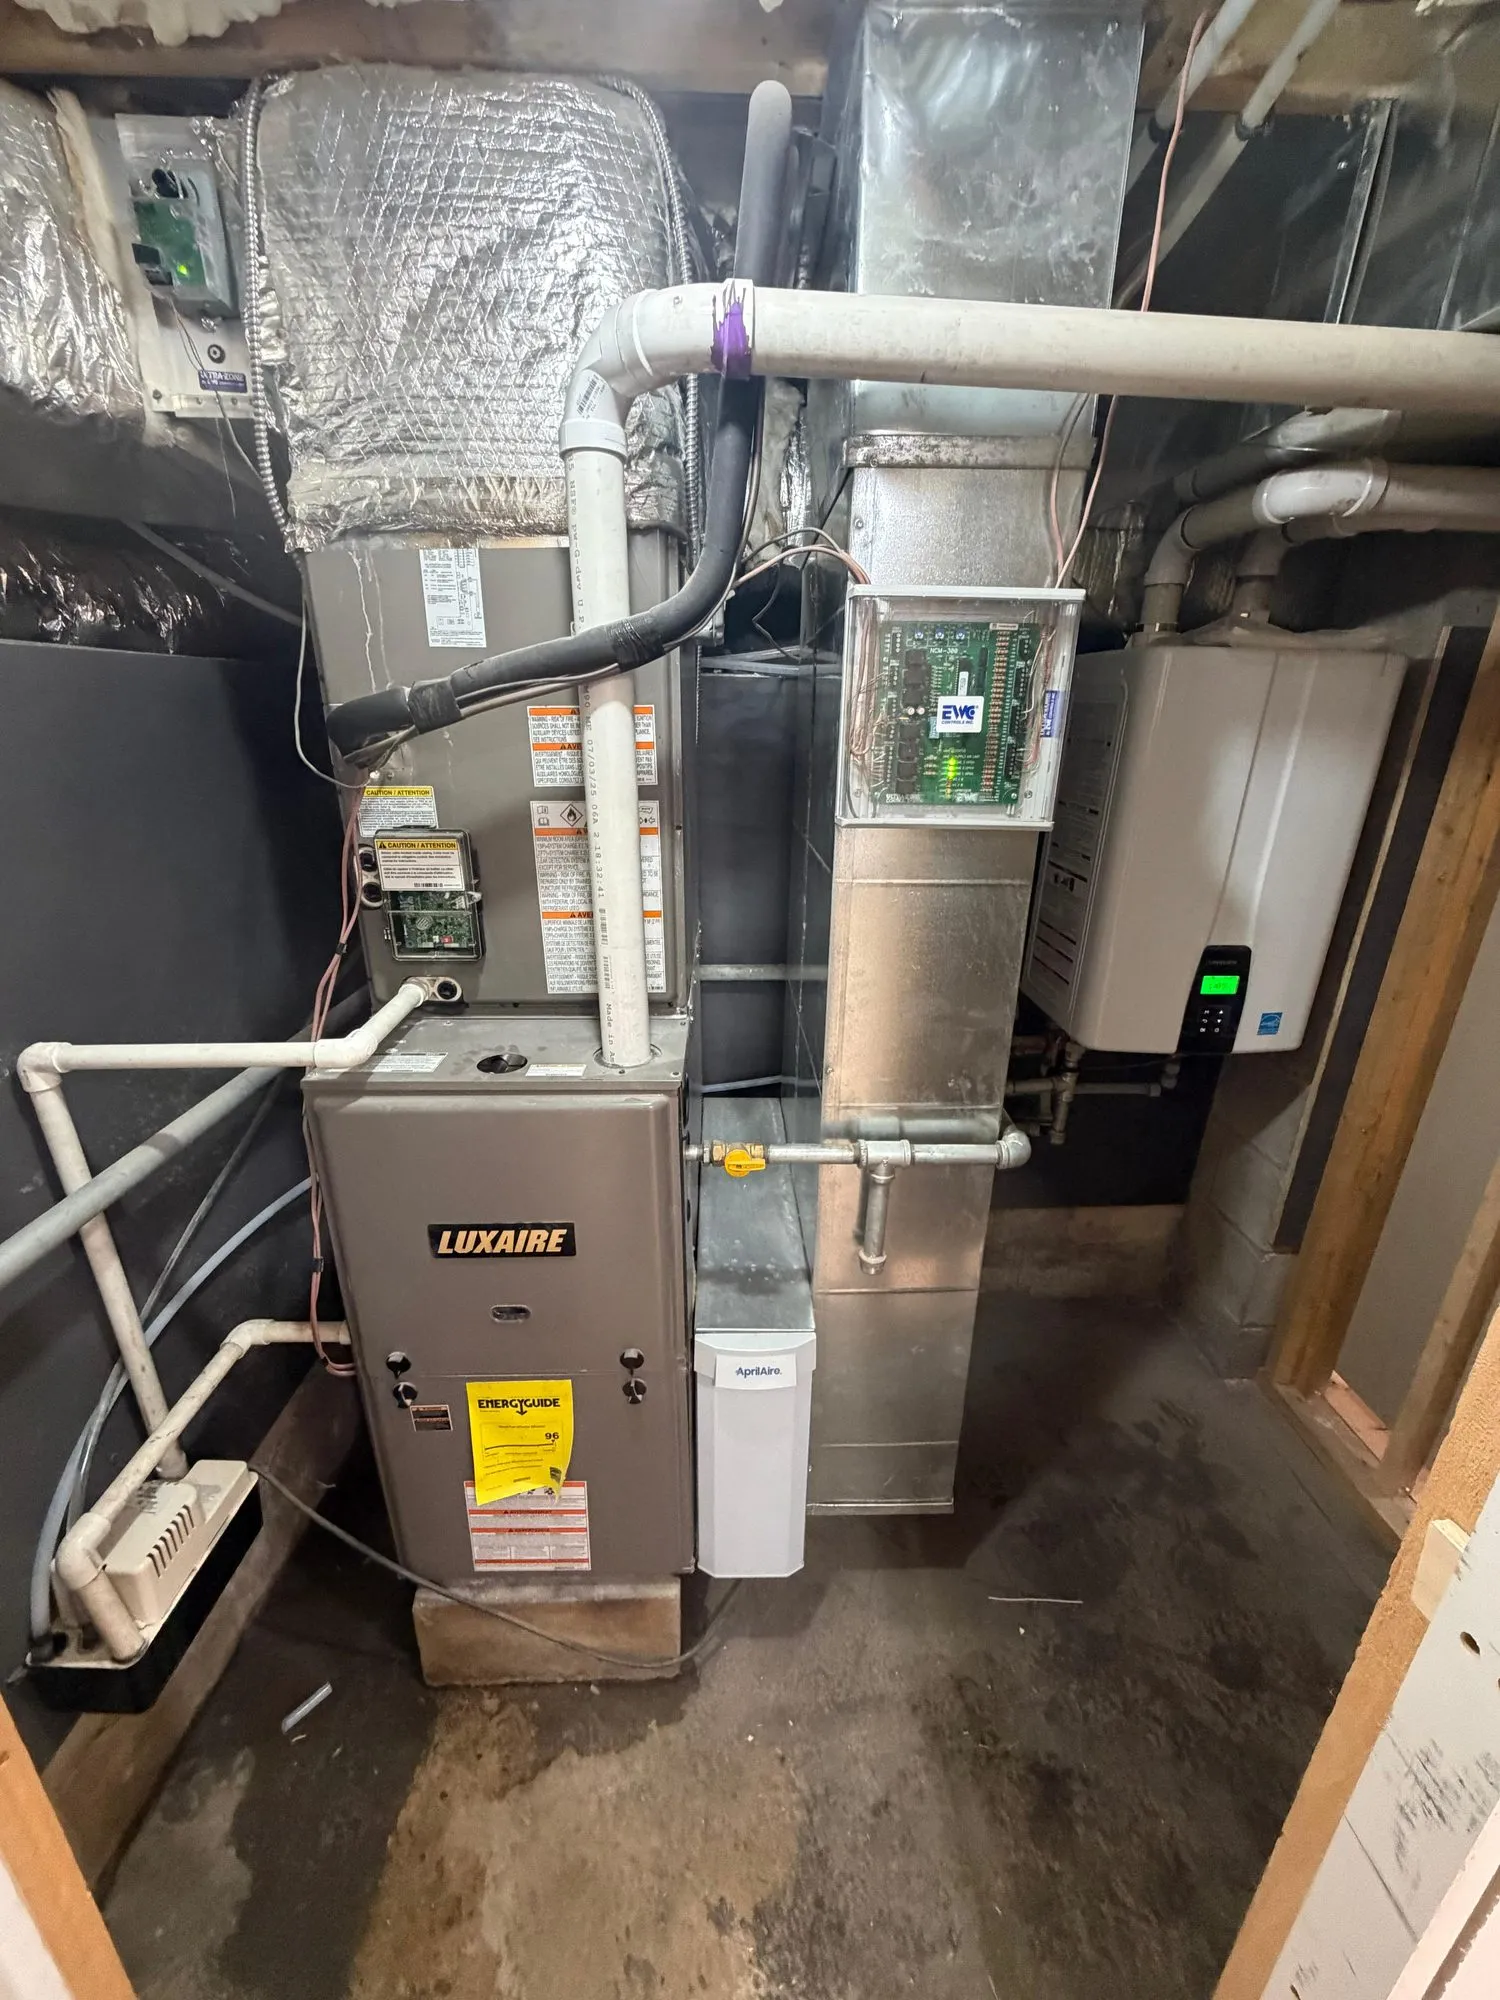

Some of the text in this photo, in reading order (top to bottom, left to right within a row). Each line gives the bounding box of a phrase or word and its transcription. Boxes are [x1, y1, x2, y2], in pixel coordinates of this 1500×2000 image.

[587, 740, 597, 796] 07/03/25
[594, 846, 604, 898] 18:32:41
[608, 1035, 614, 1045] in
[438, 1229, 567, 1254] LUXAIRE
[478, 1398, 560, 1409] ENERGYGUIDE
